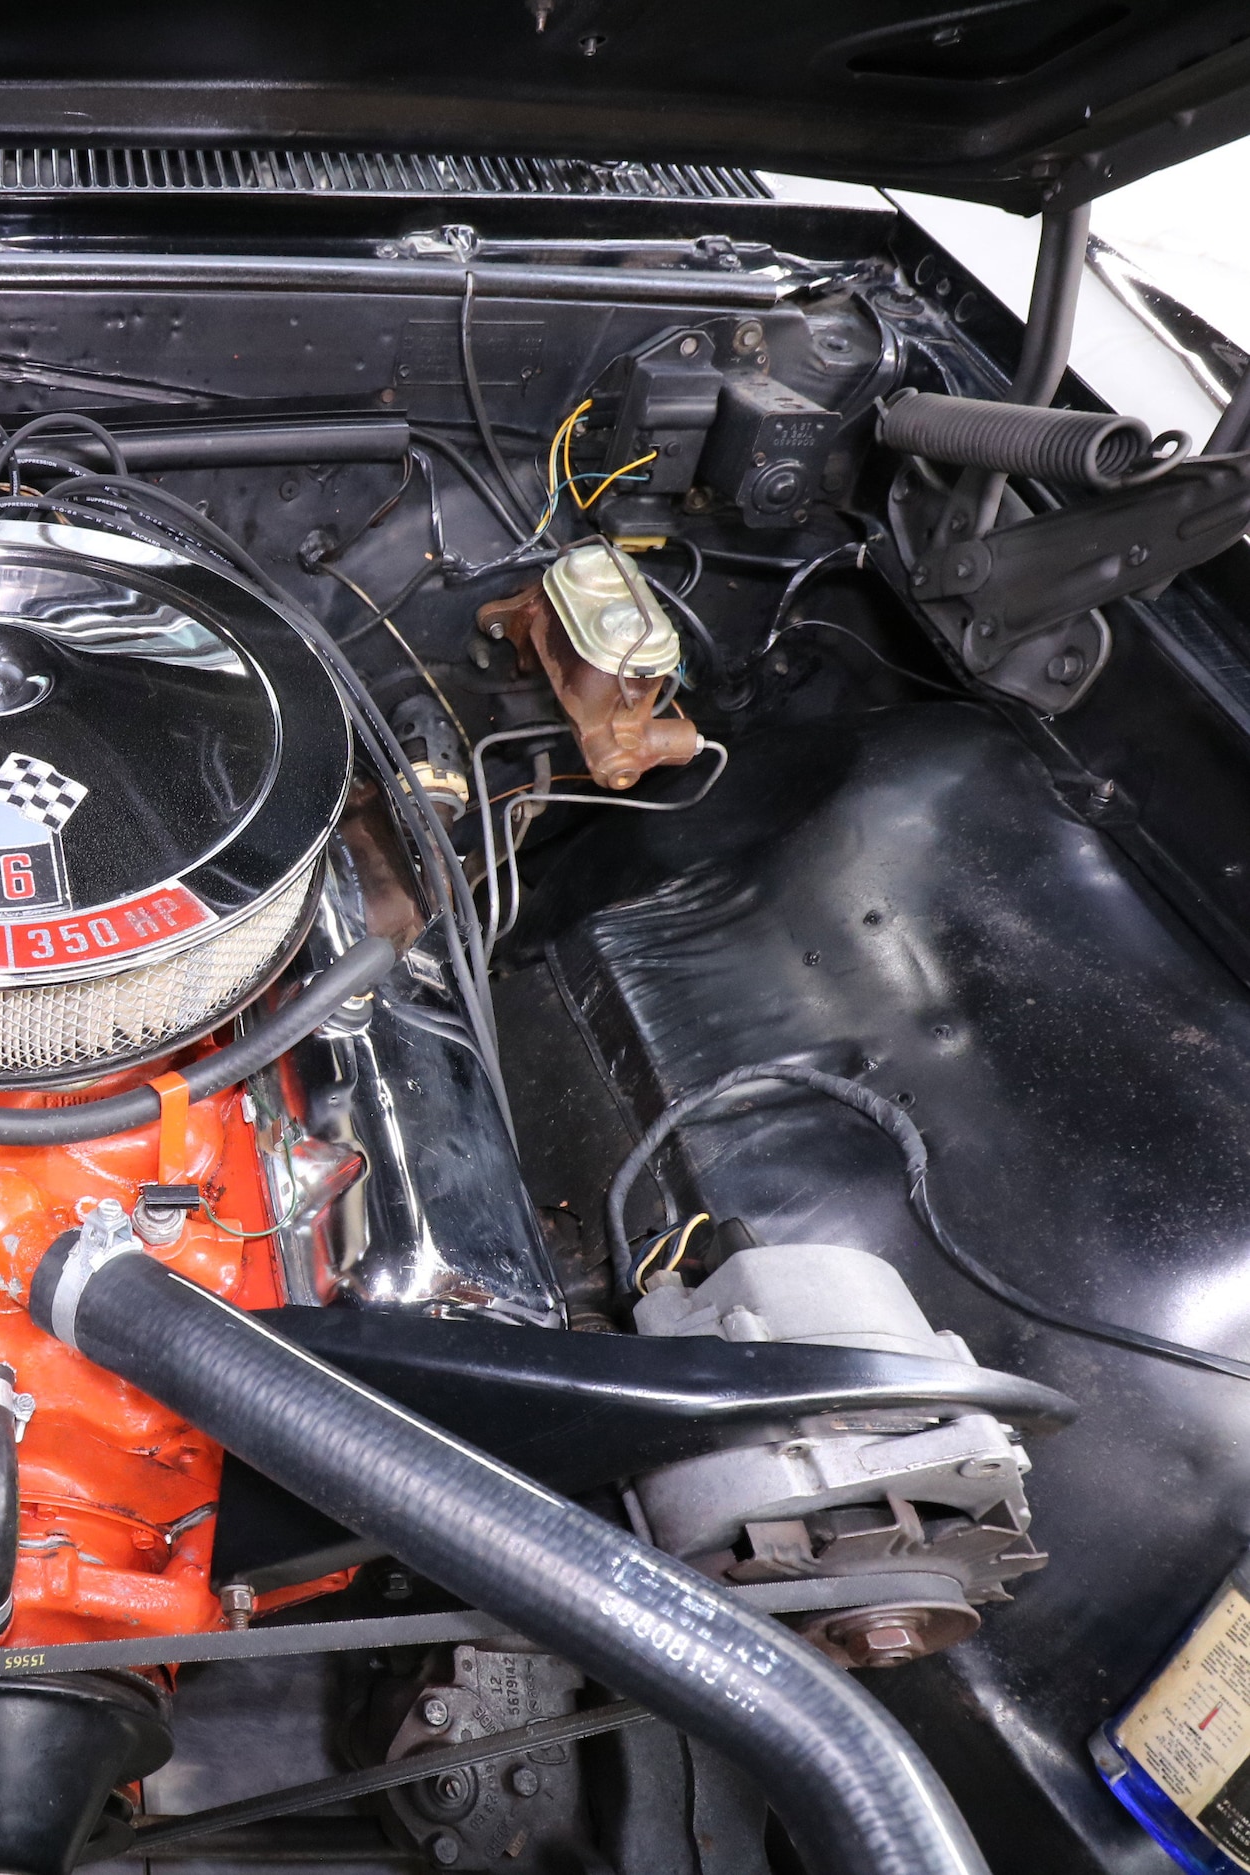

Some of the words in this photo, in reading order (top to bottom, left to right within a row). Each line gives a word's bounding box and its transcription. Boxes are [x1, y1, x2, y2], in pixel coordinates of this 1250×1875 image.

[131, 531, 162, 548] PACKARD
[27, 917, 121, 960] 350
[124, 896, 181, 939] HP
[4, 1652, 47, 1671] 15565
